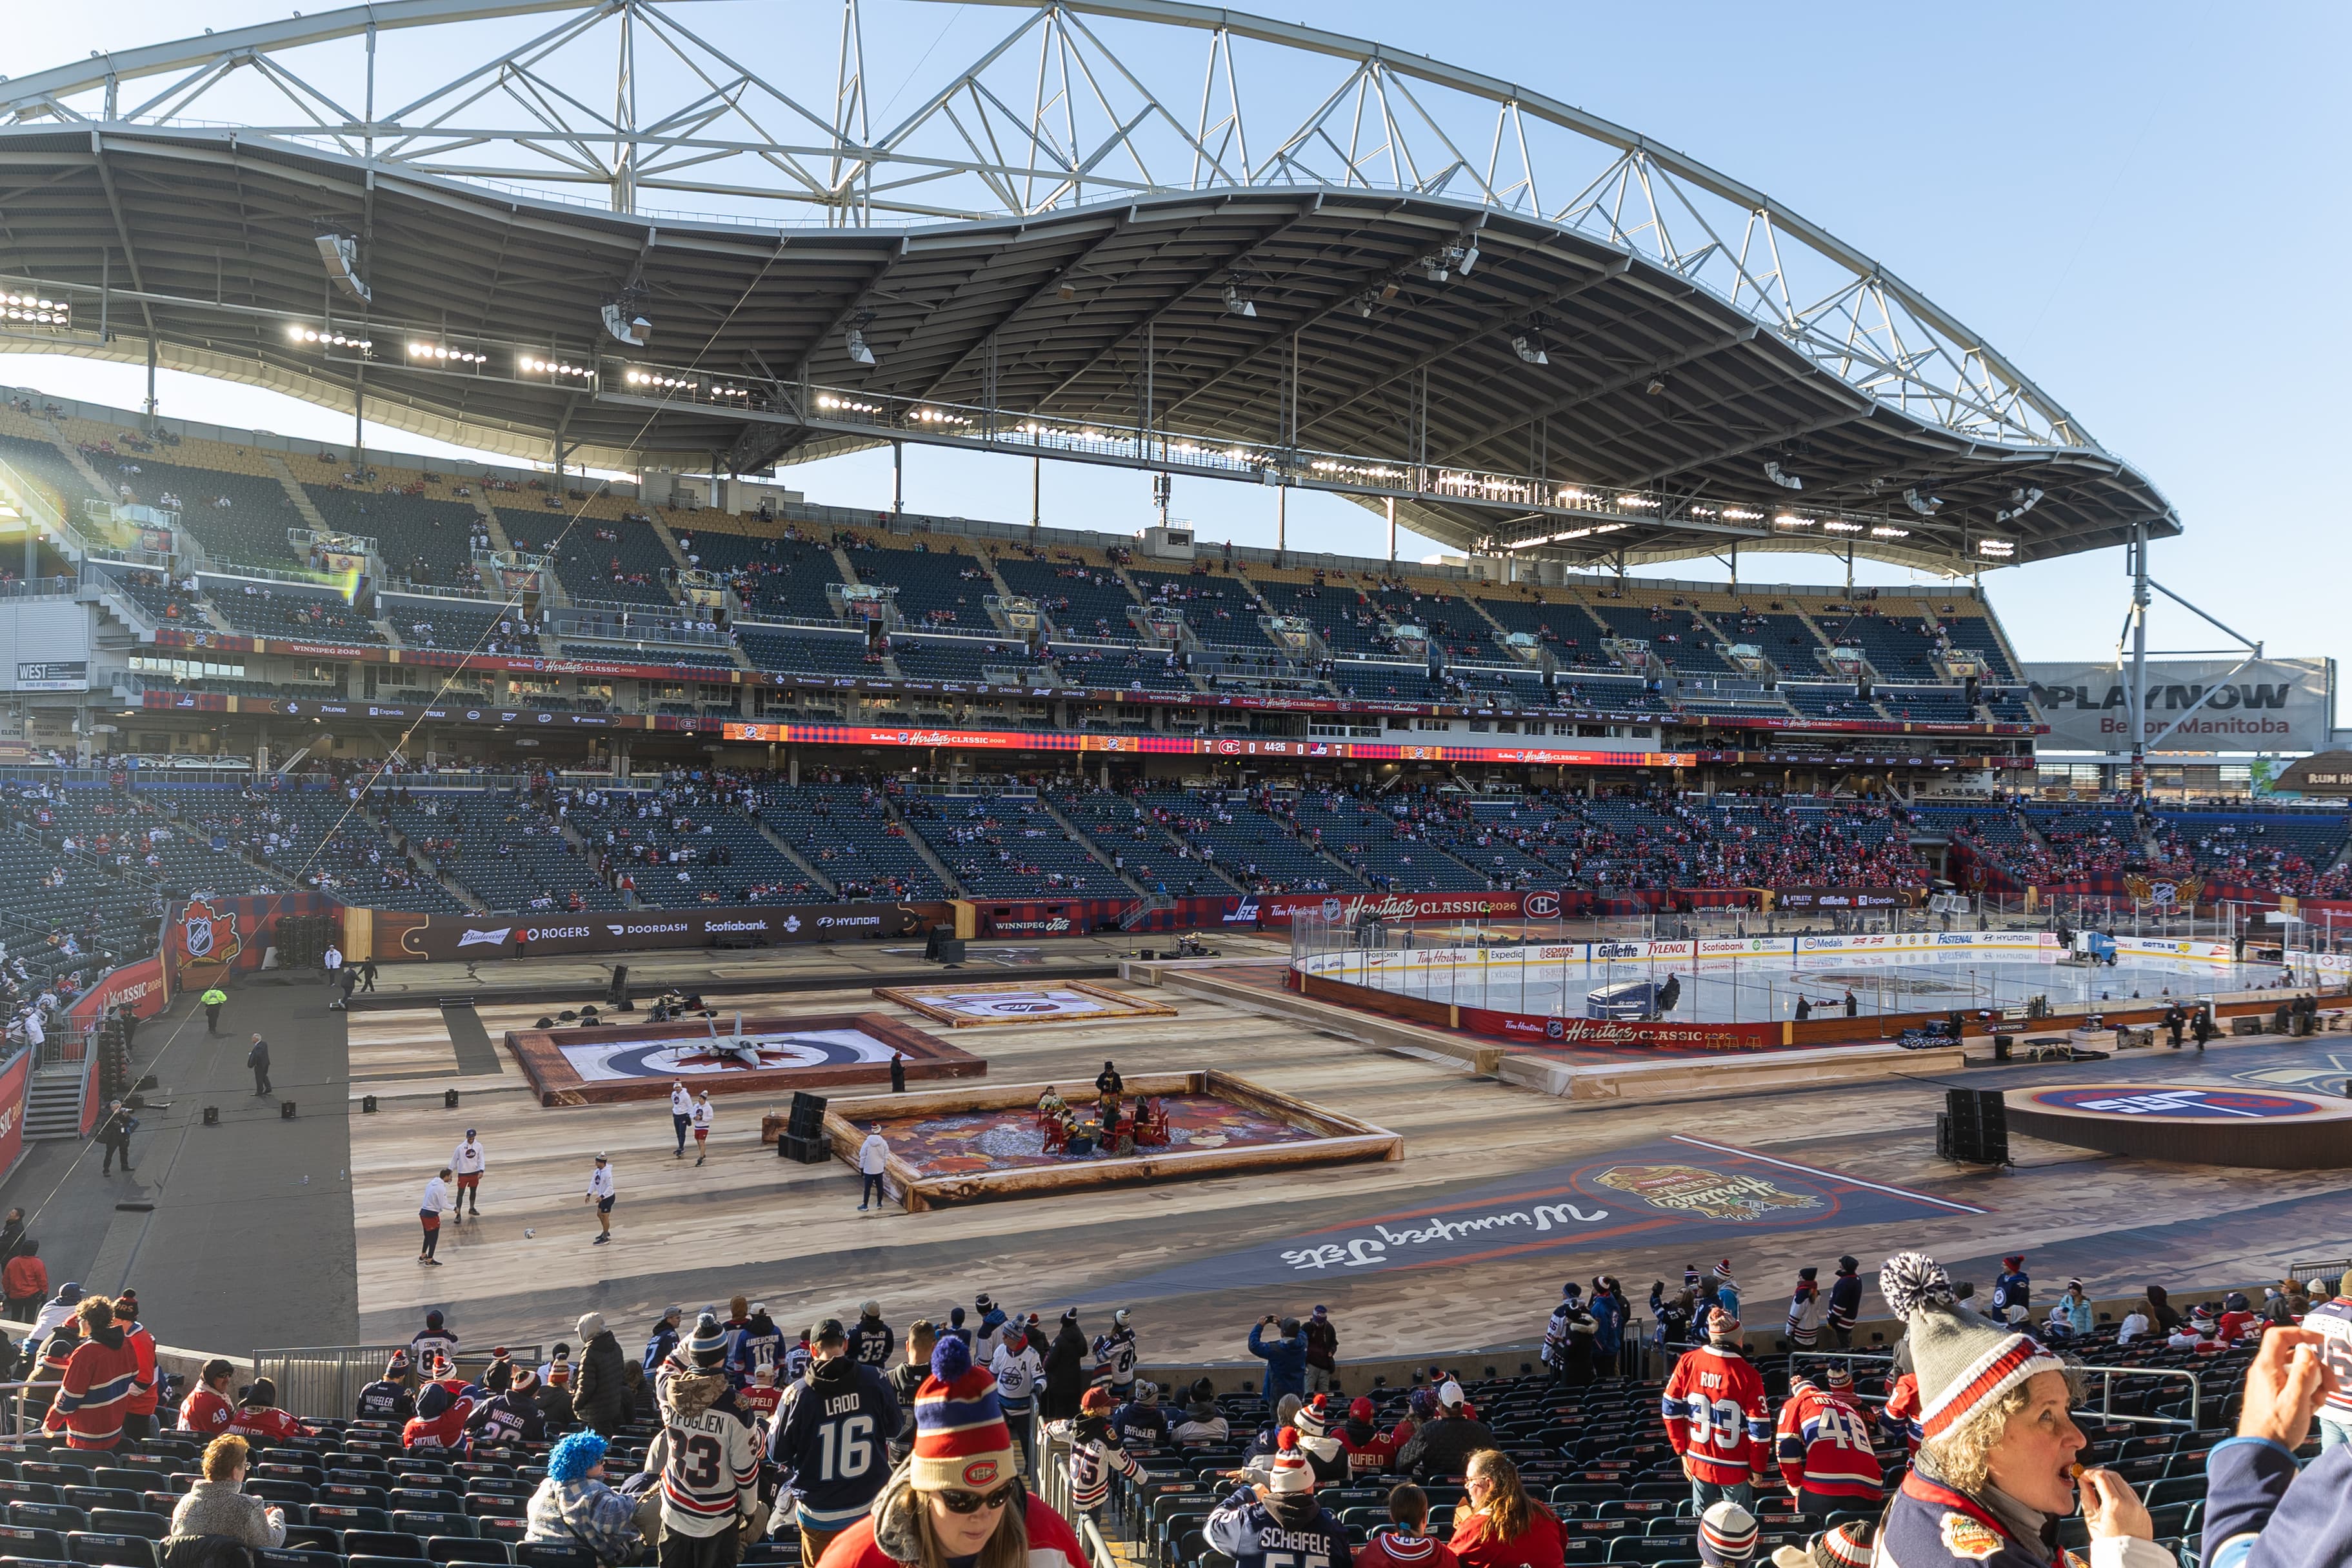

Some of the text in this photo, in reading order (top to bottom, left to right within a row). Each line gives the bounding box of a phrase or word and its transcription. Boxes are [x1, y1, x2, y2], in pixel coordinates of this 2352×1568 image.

[294, 646, 335, 654] WINNIPEG
[19, 664, 47, 679] WEST
[545, 661, 584, 673] Heritage
[1266, 699, 1291, 708] Heritage
[2048, 684, 2291, 710] PLAYNOW
[2178, 717, 2290, 734] Manitoba
[910, 731, 951, 746] Heritage
[1249, 742, 1255, 753] 0
[1264, 742, 1286, 751] 44:26
[1297, 744, 1304, 754] 0
[2133, 744, 2142, 755] 4
[1524, 750, 1553, 763] Heritage
[2309, 773, 2337, 785] RUM
[1819, 896, 1849, 905] Gillette
[1868, 896, 1895, 905] Expedia
[1271, 904, 1287, 917] Tim
[1344, 894, 1419, 924] Heritage
[1420, 900, 1484, 915] CLASSIC
[1489, 901, 1517, 911] 2026
[837, 917, 880, 926] HYUNDAI
[995, 917, 1071, 932] WINNIPEG Jets
[463, 930, 508, 942] Budweiser
[542, 926, 590, 939] ROGERS
[628, 923, 688, 935] DOORDASH
[193, 928, 207, 948] NHL
[1817, 938, 1843, 948] Medals
[1937, 933, 1973, 944] FASTENAL
[1598, 944, 1639, 958] Gillette
[1647, 942, 1688, 957] TYLENOL
[1702, 941, 1744, 952] Scotiabank
[1417, 951, 1467, 963] Tim Hortons
[1491, 949, 1524, 960] Expedia
[147, 978, 162, 993] 2026
[1504, 1020, 1517, 1030] Tim
[1518, 1021, 1544, 1033] Hortons
[1566, 1019, 1639, 1046] Heritage
[1639, 1031, 1702, 1042] CLASSIC
[1646, 1175, 1777, 1209] Heritage
[1648, 1178, 1722, 1195] CLASSIC
[1280, 1203, 1610, 1269] Winnipeg Jets
[746, 1335, 779, 1347] HAWERCHUK
[753, 1344, 775, 1369] 10
[857, 1340, 886, 1363] 33
[421, 1348, 444, 1371] 81
[1020, 1361, 1028, 1373] A
[1701, 1371, 1722, 1389] ROY
[366, 1394, 394, 1407] WHEELER
[748, 1396, 773, 1407] UFIELD
[825, 1393, 861, 1416] LADD
[1812, 1396, 1857, 1414] HUTSON
[213, 1408, 228, 1424] 48
[492, 1408, 524, 1429] WHEELER
[1687, 1391, 1741, 1449] 33
[1124, 1424, 1157, 1440] BYFUGLIEN
[1817, 1407, 1875, 1456] 48
[414, 1434, 443, 1447] SUZUKI
[818, 1414, 875, 1481] 16
[666, 1427, 722, 1488] 33
[1348, 1453, 1384, 1466] AUFIELD
[1261, 1526, 1331, 1556] SCHEIFELE
